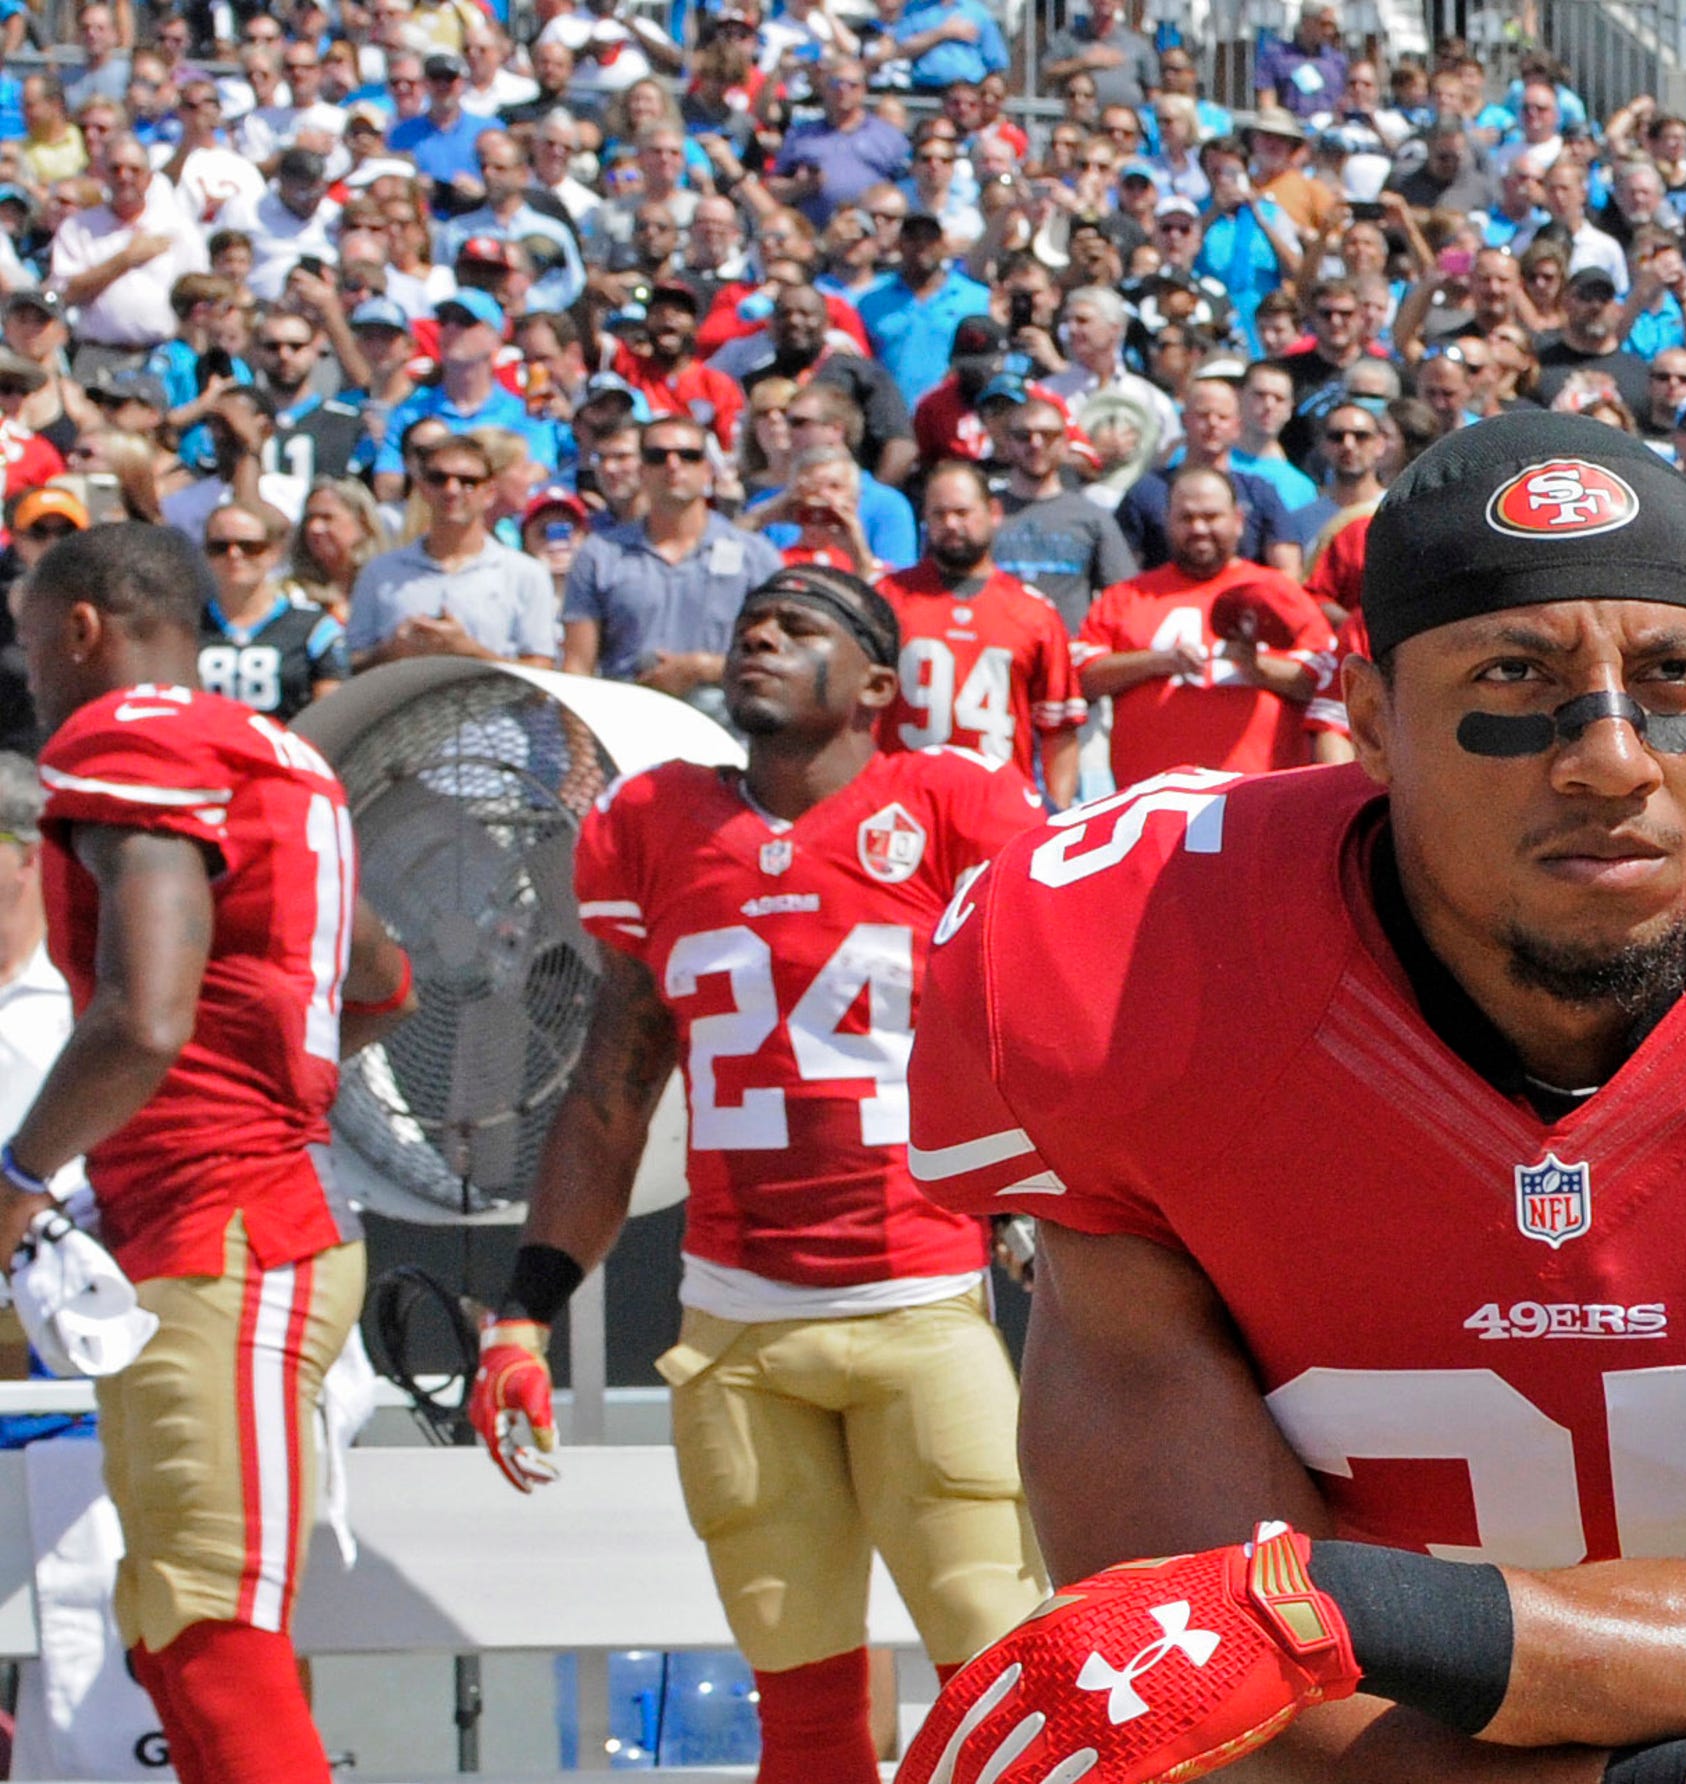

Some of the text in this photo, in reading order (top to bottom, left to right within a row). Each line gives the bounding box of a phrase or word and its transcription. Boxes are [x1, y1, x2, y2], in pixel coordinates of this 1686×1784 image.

[1526, 468, 1611, 525] SF
[198, 646, 281, 711] 88
[898, 637, 1014, 767] 94
[667, 924, 914, 1150] 24
[1528, 1197, 1582, 1231] NFL
[1463, 1302, 1668, 1340] 49ERS
